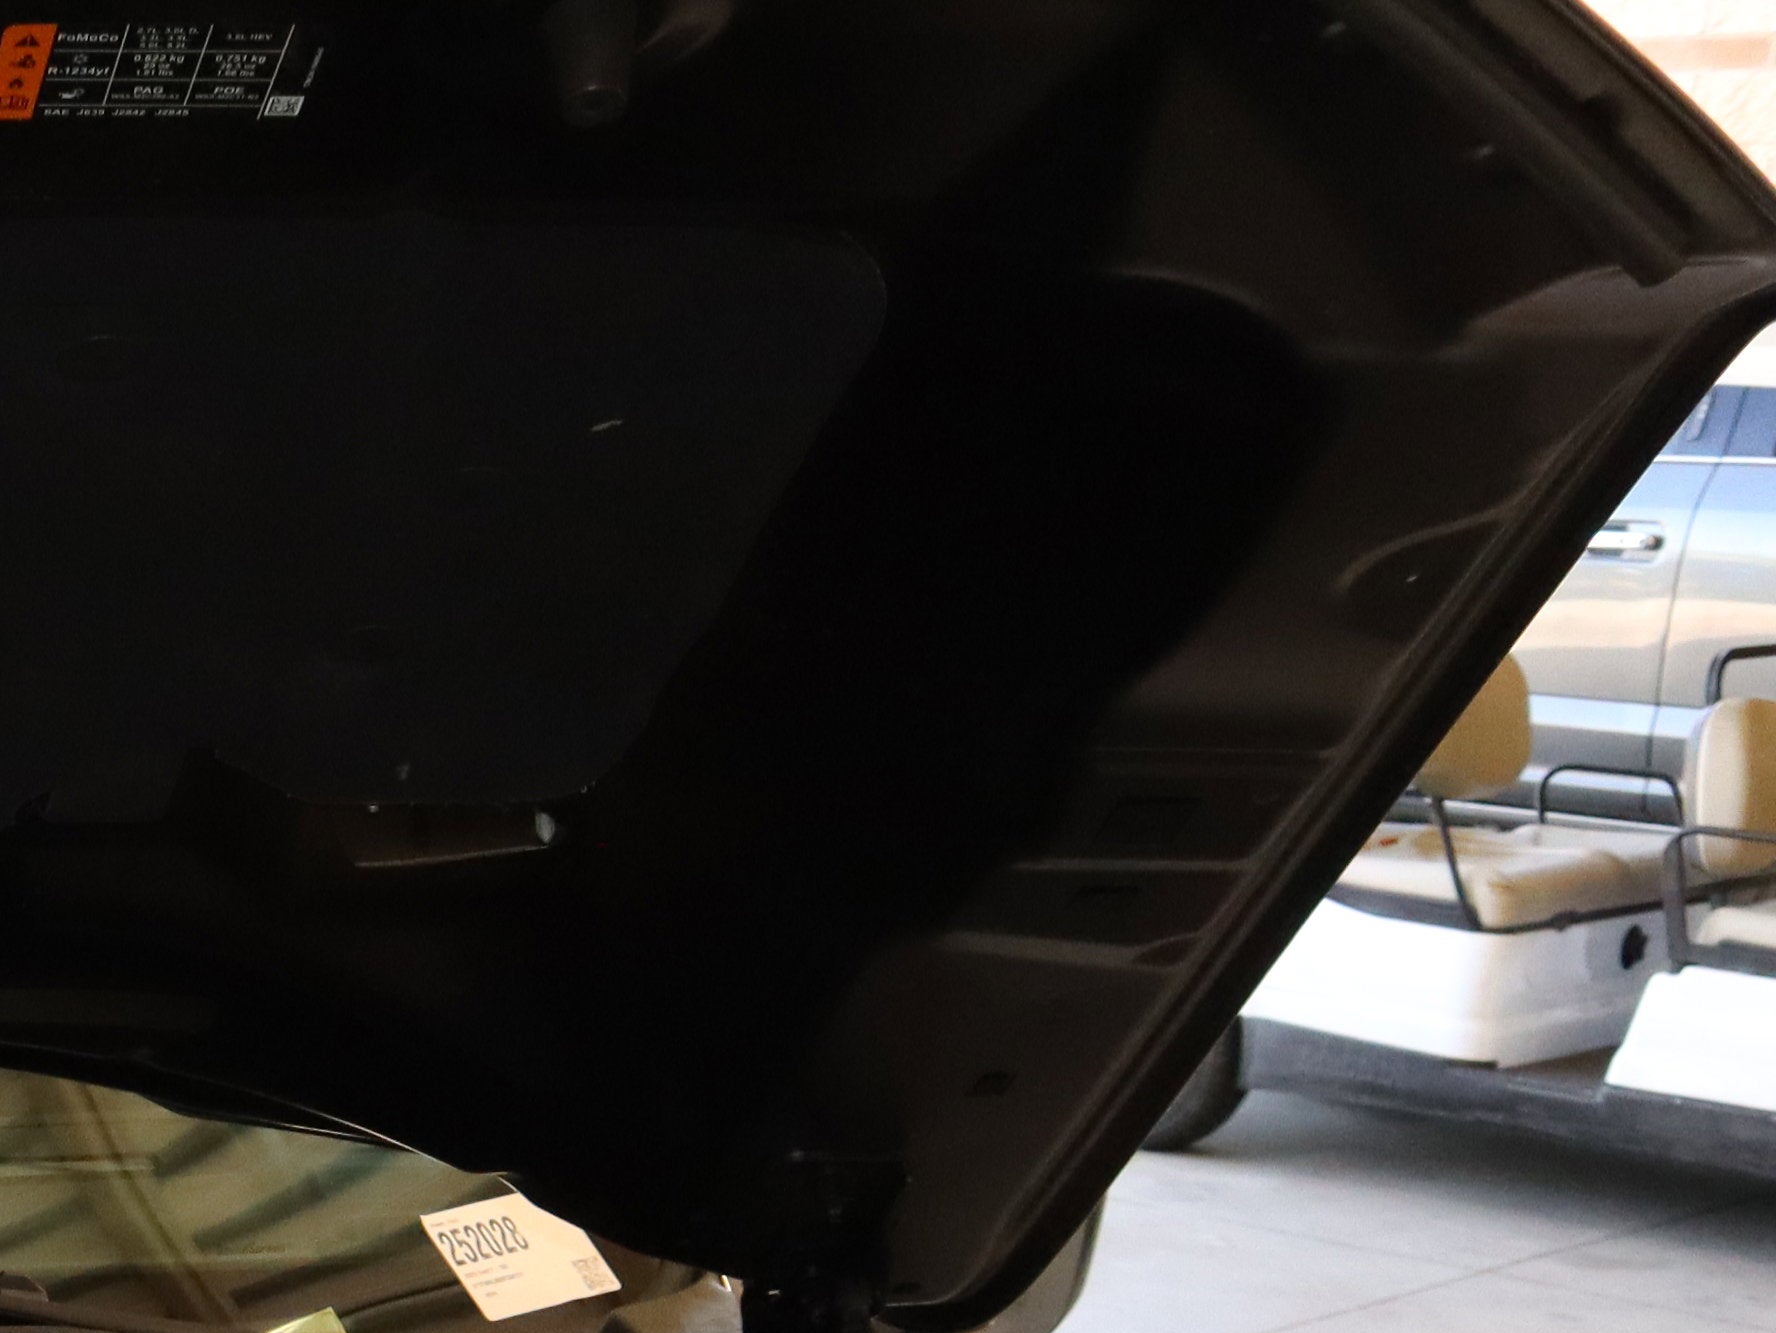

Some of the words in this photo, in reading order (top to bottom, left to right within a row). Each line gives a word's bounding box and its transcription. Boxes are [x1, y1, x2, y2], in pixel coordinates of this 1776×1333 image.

[57, 33, 119, 42] FoMoCo
[169, 54, 185, 64] kg
[251, 54, 267, 64] kg
[48, 66, 110, 76] R-1234yf
[133, 86, 164, 95] PAG
[213, 86, 244, 95] POE
[437, 1215, 530, 1267] 252028
